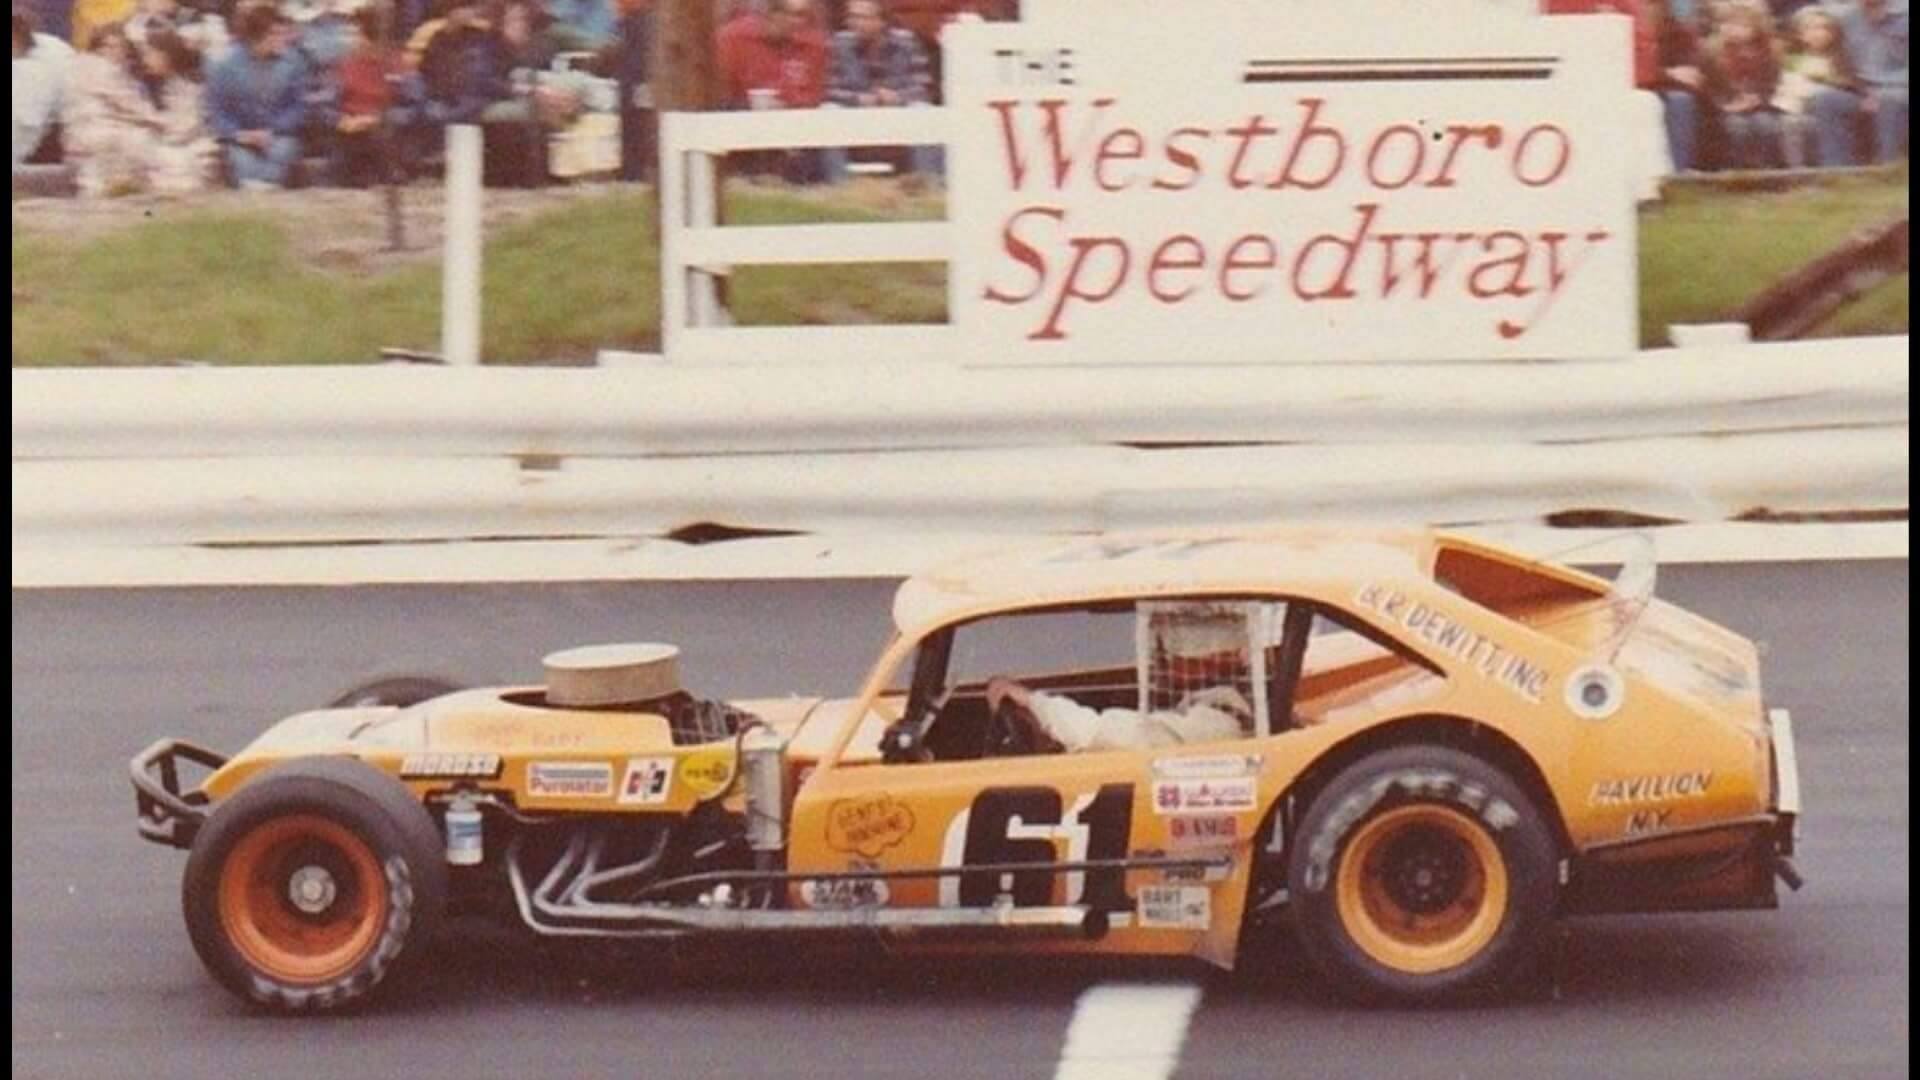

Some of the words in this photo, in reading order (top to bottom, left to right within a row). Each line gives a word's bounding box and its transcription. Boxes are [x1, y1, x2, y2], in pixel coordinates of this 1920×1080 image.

[986, 97, 1571, 191] Westboro
[984, 203, 1609, 341] Speedway
[1589, 770, 1714, 806] PAVILION
[957, 782, 1136, 909] 61
